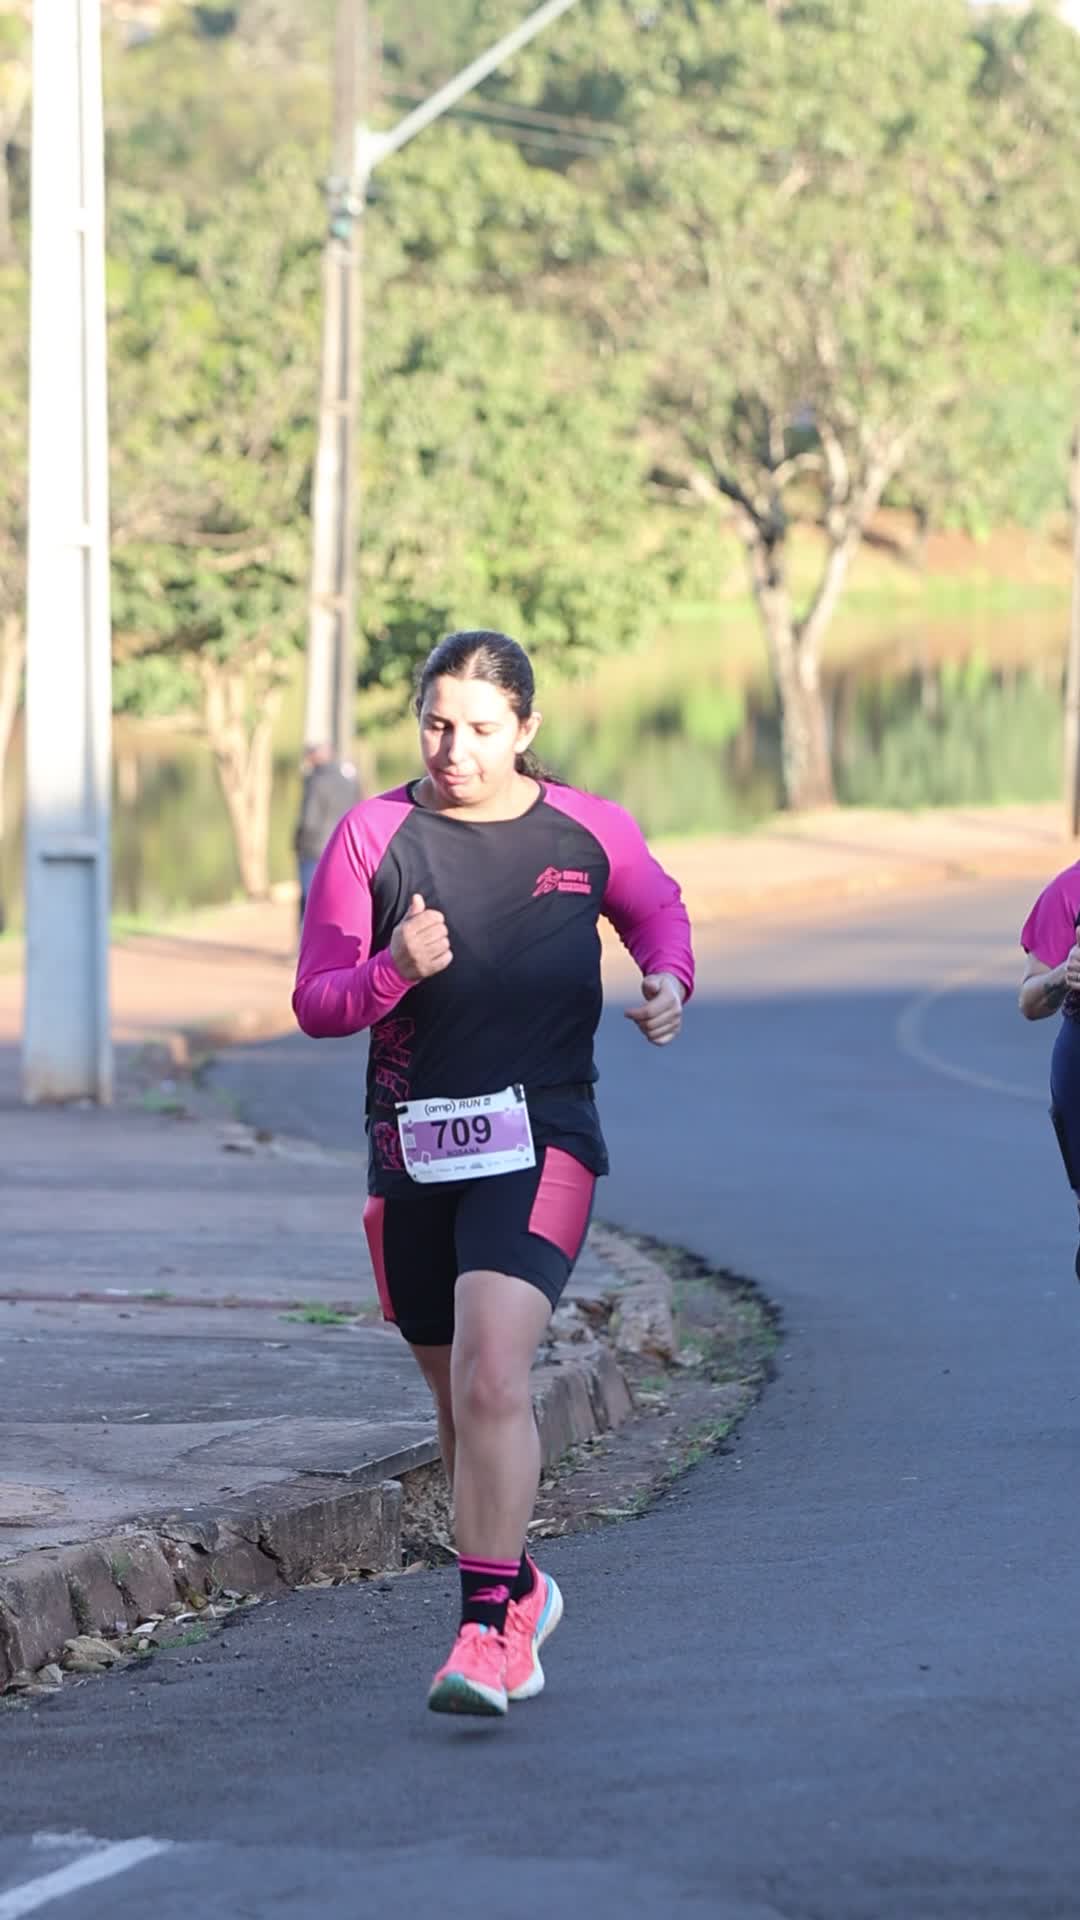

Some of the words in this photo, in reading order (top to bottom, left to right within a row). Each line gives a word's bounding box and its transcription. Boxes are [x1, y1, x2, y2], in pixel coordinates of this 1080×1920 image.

[424, 1100, 456, 1116] (amp)
[459, 1099, 480, 1109] RUN
[430, 1115, 491, 1149] 709
